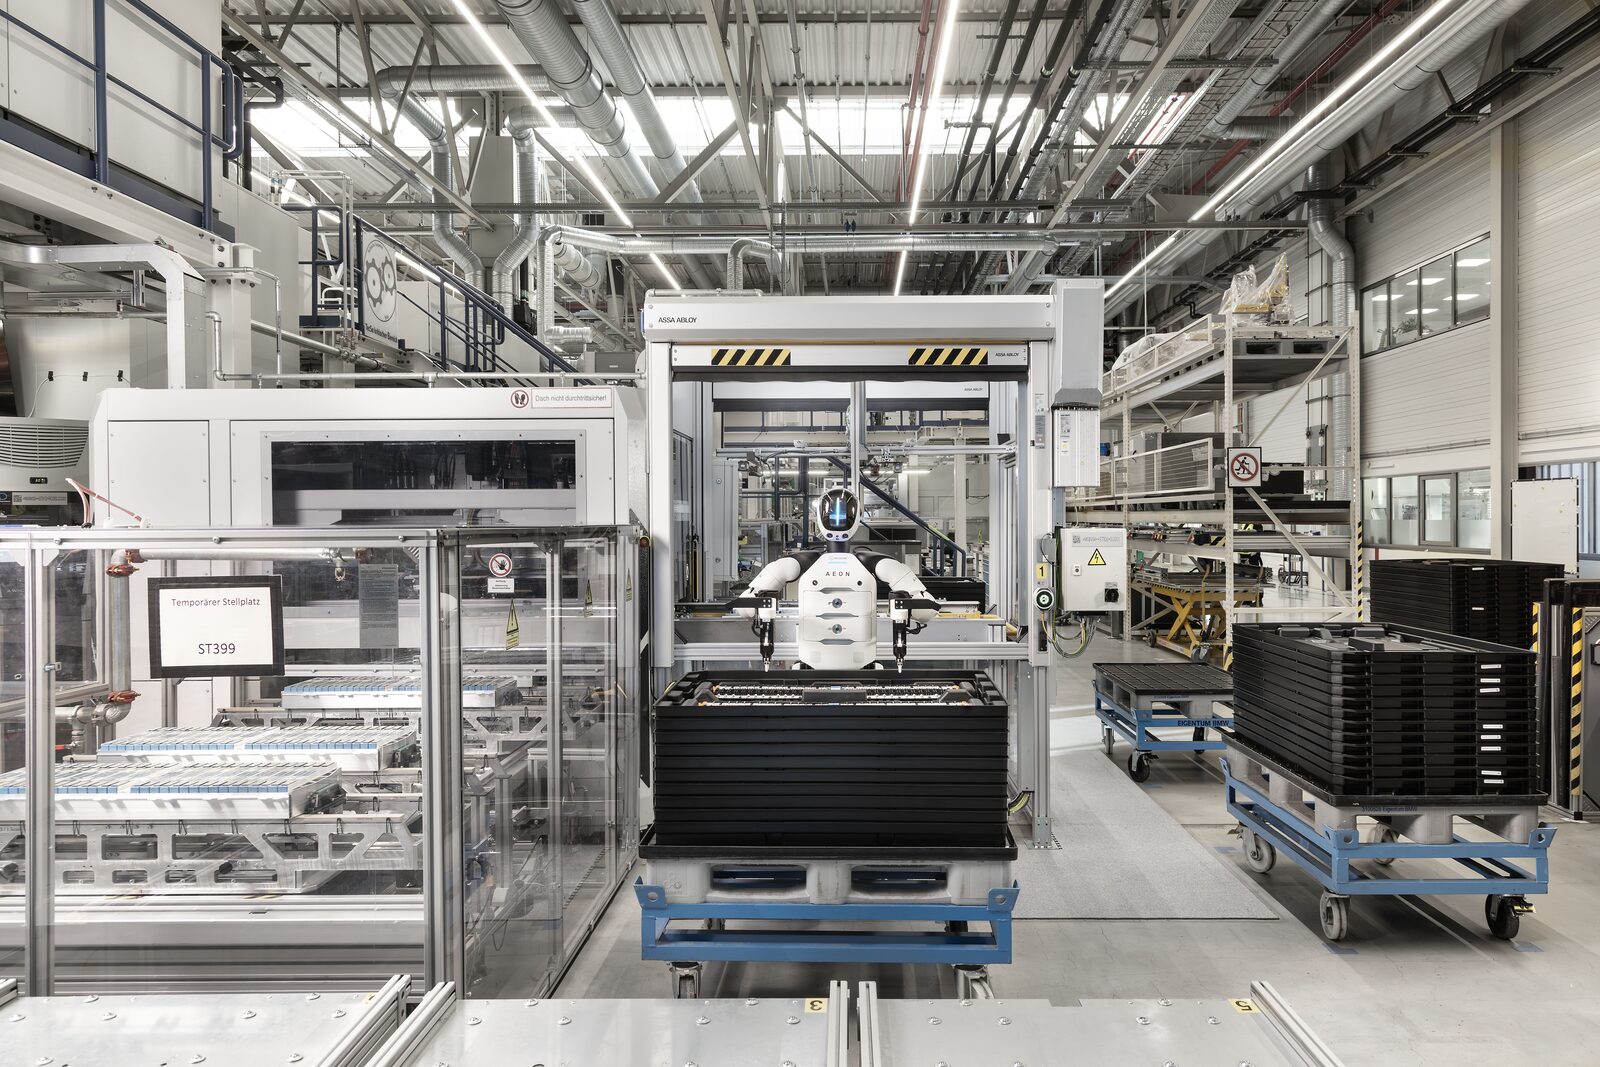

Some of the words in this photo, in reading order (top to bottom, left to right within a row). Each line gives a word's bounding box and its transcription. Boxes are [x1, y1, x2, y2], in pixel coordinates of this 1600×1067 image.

[1039, 566, 1044, 577] 1
[171, 598, 220, 607] Temporärer
[223, 597, 260, 607] Stellplatz
[198, 643, 236, 654] ST399
[809, 1000, 823, 1011] 3
[1235, 1000, 1253, 1011] 5
